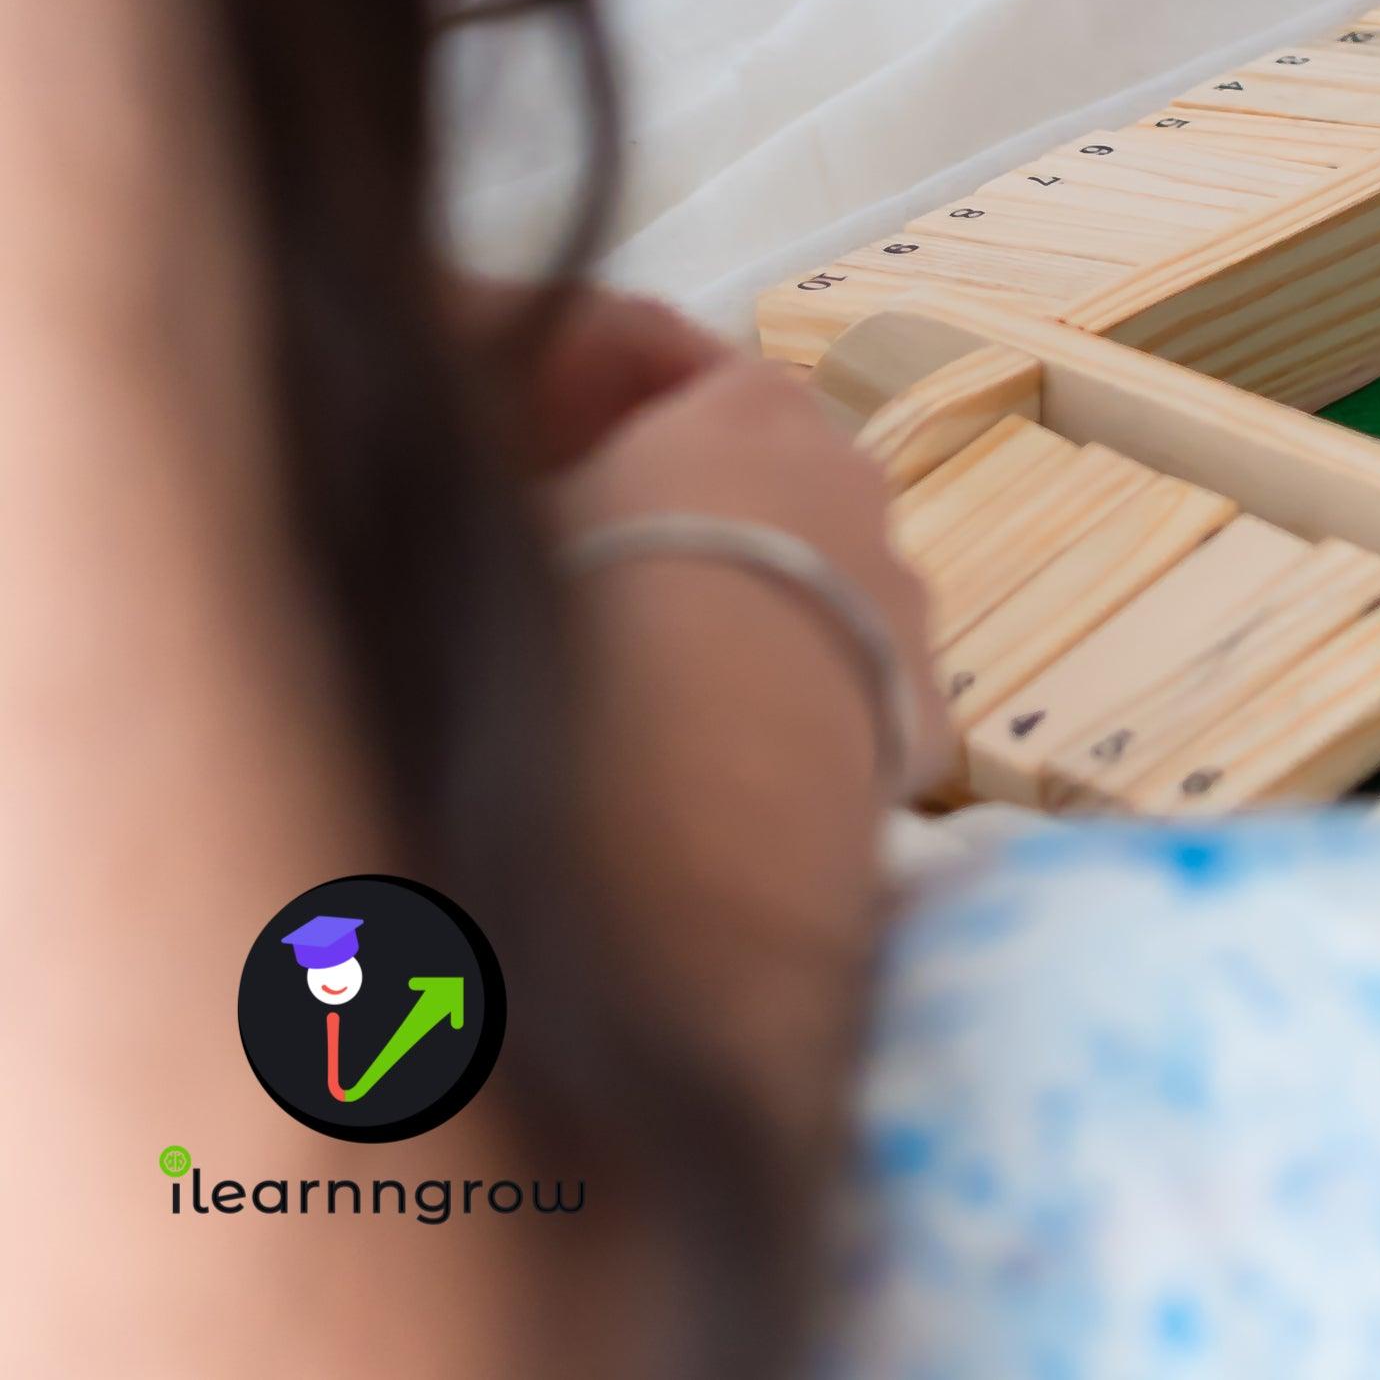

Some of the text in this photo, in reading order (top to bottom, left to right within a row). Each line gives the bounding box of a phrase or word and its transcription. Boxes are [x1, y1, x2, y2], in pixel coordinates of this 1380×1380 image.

[1154, 117, 1191, 130] 5
[1079, 144, 1115, 156] 6
[1027, 174, 1062, 187] 7
[949, 207, 985, 220] 8
[883, 242, 920, 255] 9
[797, 272, 848, 293] 10
